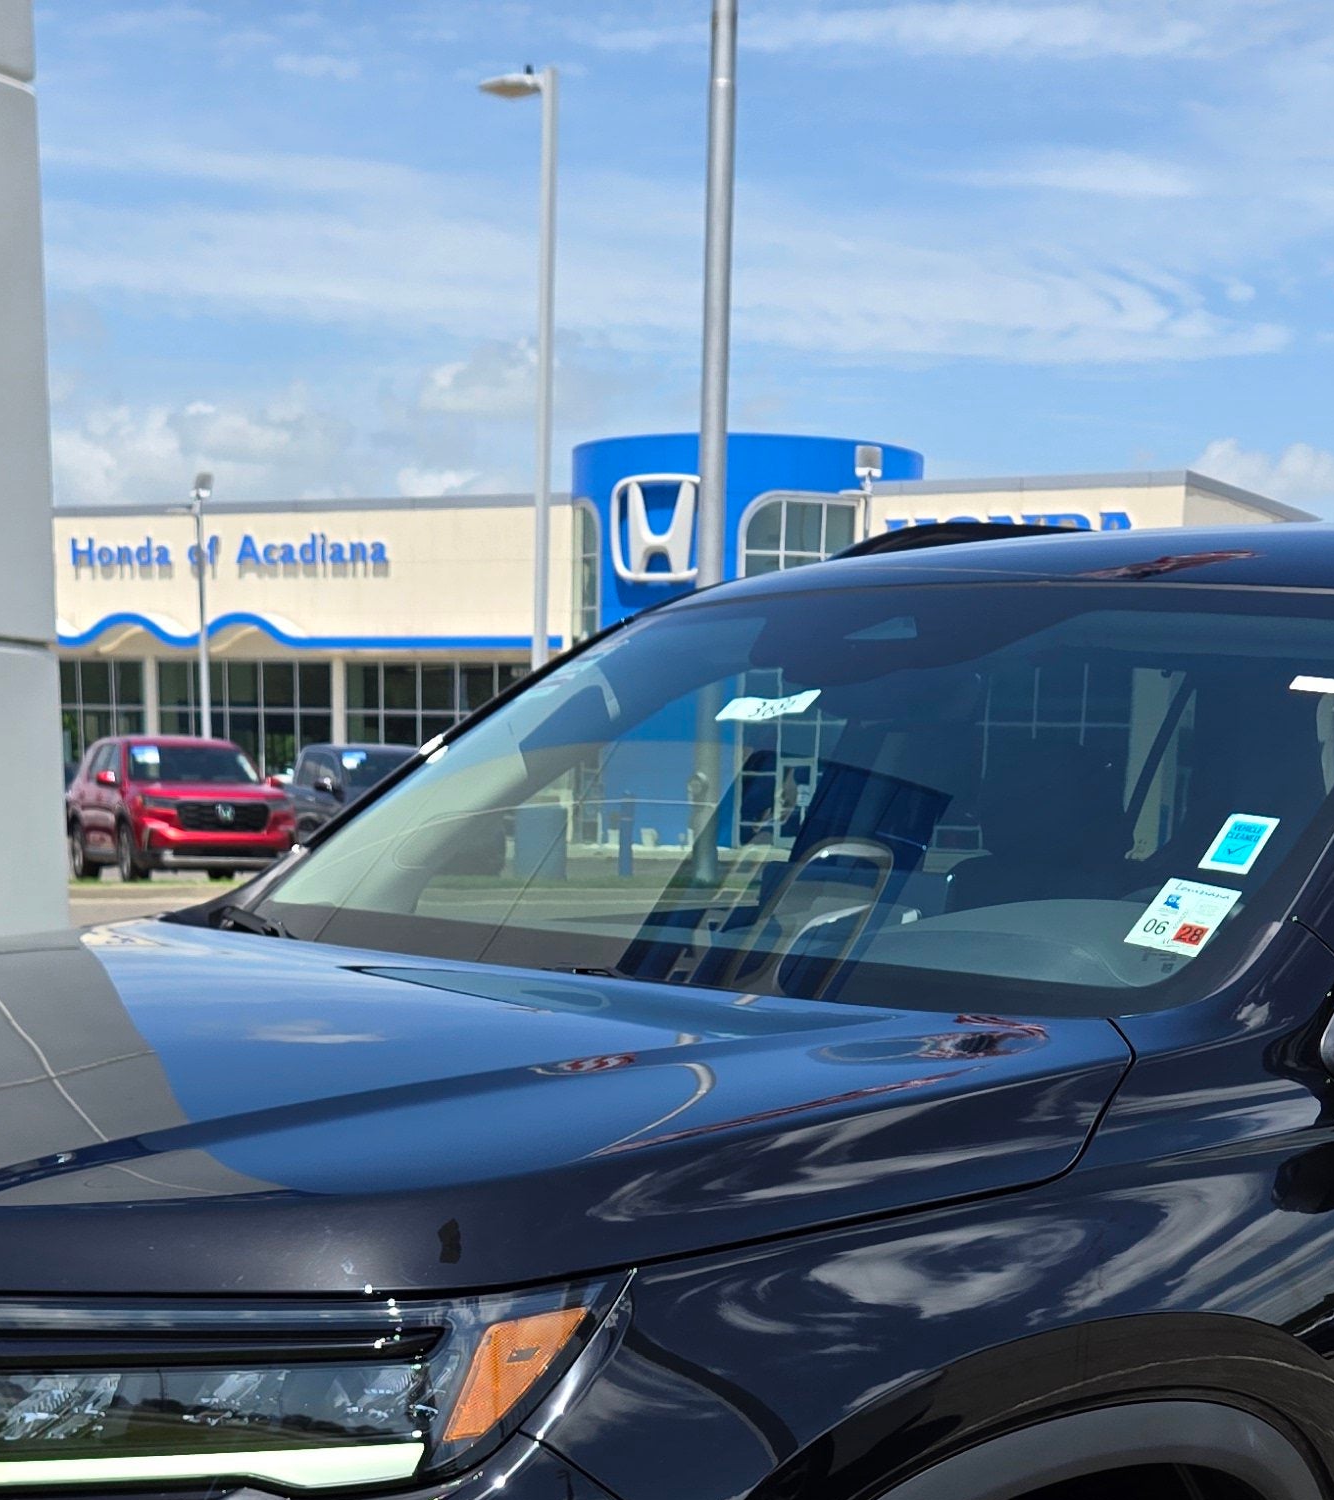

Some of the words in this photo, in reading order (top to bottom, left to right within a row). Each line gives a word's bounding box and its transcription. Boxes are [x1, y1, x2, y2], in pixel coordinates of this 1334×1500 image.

[70, 537, 172, 567] Honda
[188, 534, 221, 566] of
[235, 532, 387, 565] Acadiana
[1227, 831, 1261, 842] CLEANED
[1234, 823, 1266, 834] VEHICLE
[1142, 918, 1170, 936] 06
[1176, 926, 1206, 943] 28
